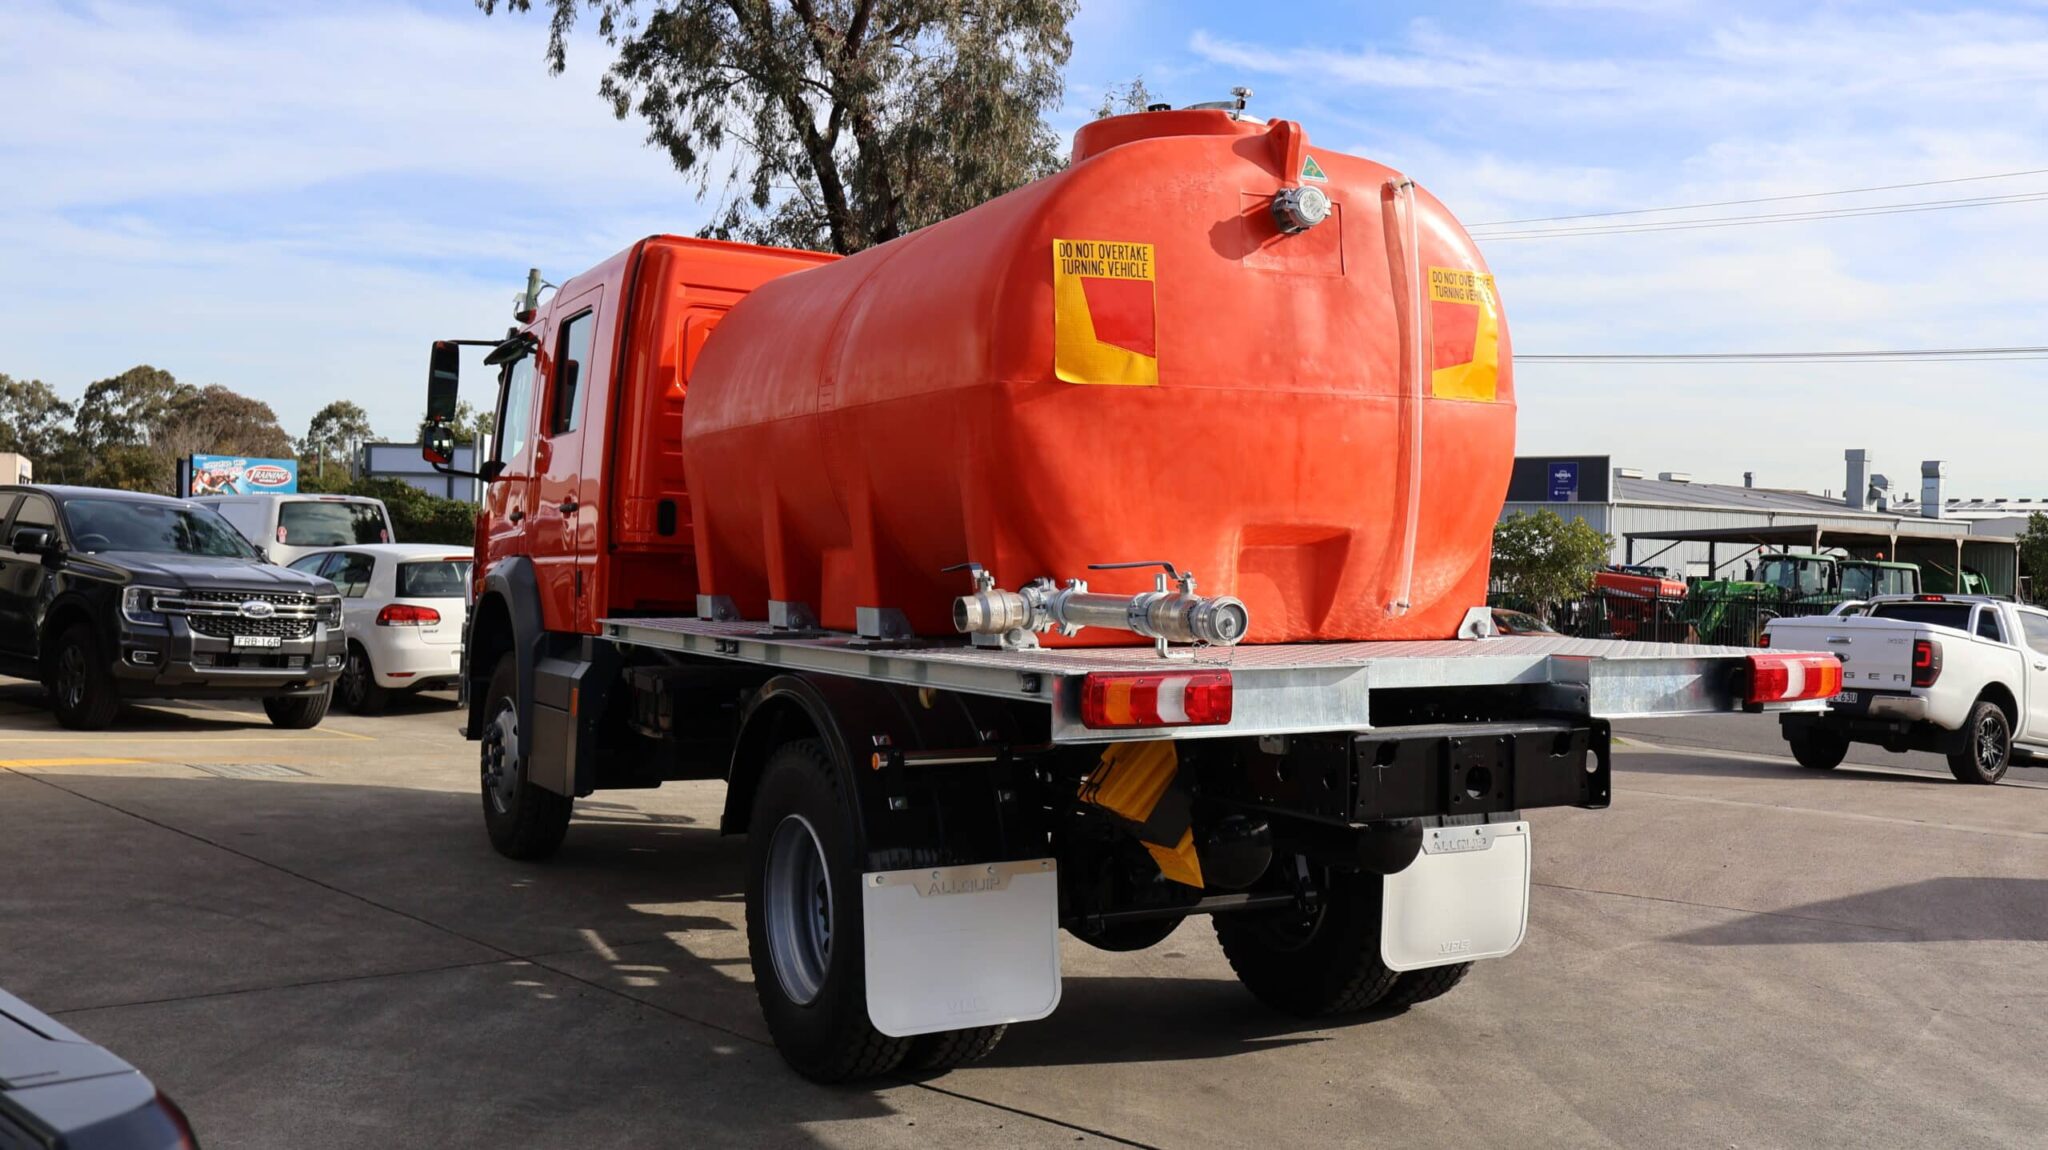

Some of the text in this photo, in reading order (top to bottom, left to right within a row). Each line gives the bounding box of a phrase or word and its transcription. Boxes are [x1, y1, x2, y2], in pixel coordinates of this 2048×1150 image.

[1059, 242, 1149, 262] DO NOT OVERTAKE
[1062, 259, 1148, 278] TURNING VEHICLE
[1432, 271, 1442, 283] DO
[1444, 272, 1457, 285] NOT
[1435, 285, 1492, 304] TURNING VEHE
[1843, 671, 1906, 682] GER
